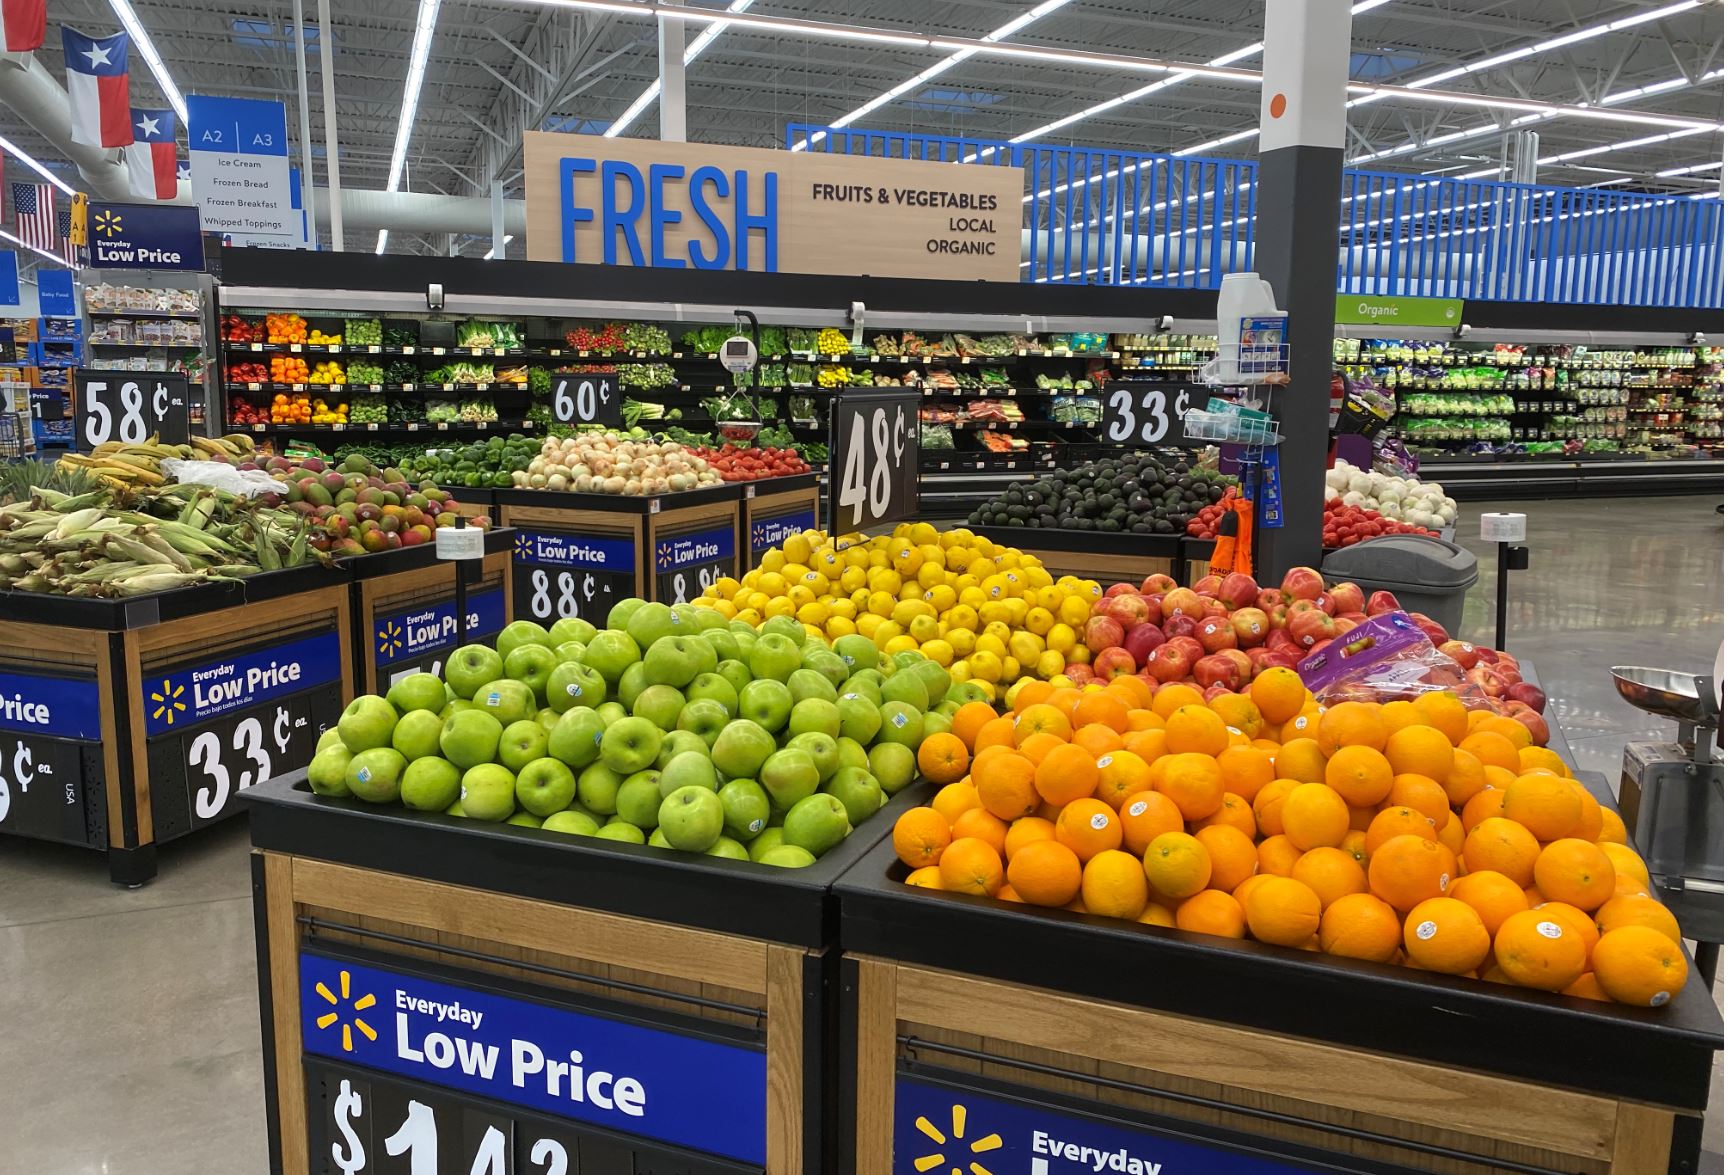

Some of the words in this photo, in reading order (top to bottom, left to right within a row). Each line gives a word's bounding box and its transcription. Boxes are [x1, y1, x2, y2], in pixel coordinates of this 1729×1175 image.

[202, 130, 222, 142] A2
[253, 134, 272, 146] A3
[233, 160, 261, 168] Cream
[213, 178, 241, 187] Frozen
[244, 179, 268, 188] Bread
[207, 198, 235, 206] Frozen
[238, 199, 277, 208] Breakfast
[813, 183, 873, 203] FRUITS
[878, 188, 889, 204] &
[894, 189, 997, 210] VEGETABLES
[560, 157, 777, 272] FRESH
[204, 217, 242, 227] Whipped
[245, 219, 281, 229] Toppings
[949, 217, 996, 233] LOCAL
[97, 240, 131, 248] Everyday
[927, 239, 995, 255] ORGANIC
[98, 248, 134, 262] Low
[138, 249, 181, 263] Price
[1358, 303, 1398, 318] Organic
[538, 536, 562, 545] Everyday
[766, 529, 782, 543] Low
[538, 543, 567, 560] Low
[569, 545, 606, 563] Price
[674, 549, 694, 564] Low
[696, 543, 718, 559] Price
[406, 611, 435, 625] Everyday
[407, 623, 440, 647] Low
[193, 664, 235, 682] Everyday
[194, 678, 243, 709] Low
[247, 661, 301, 693] Price
[64, 783, 75, 805] USA
[395, 989, 483, 1031] Everyday
[396, 1011, 500, 1080] Low
[511, 1039, 646, 1118] Price
[1032, 1131, 1162, 1175] Everyday
